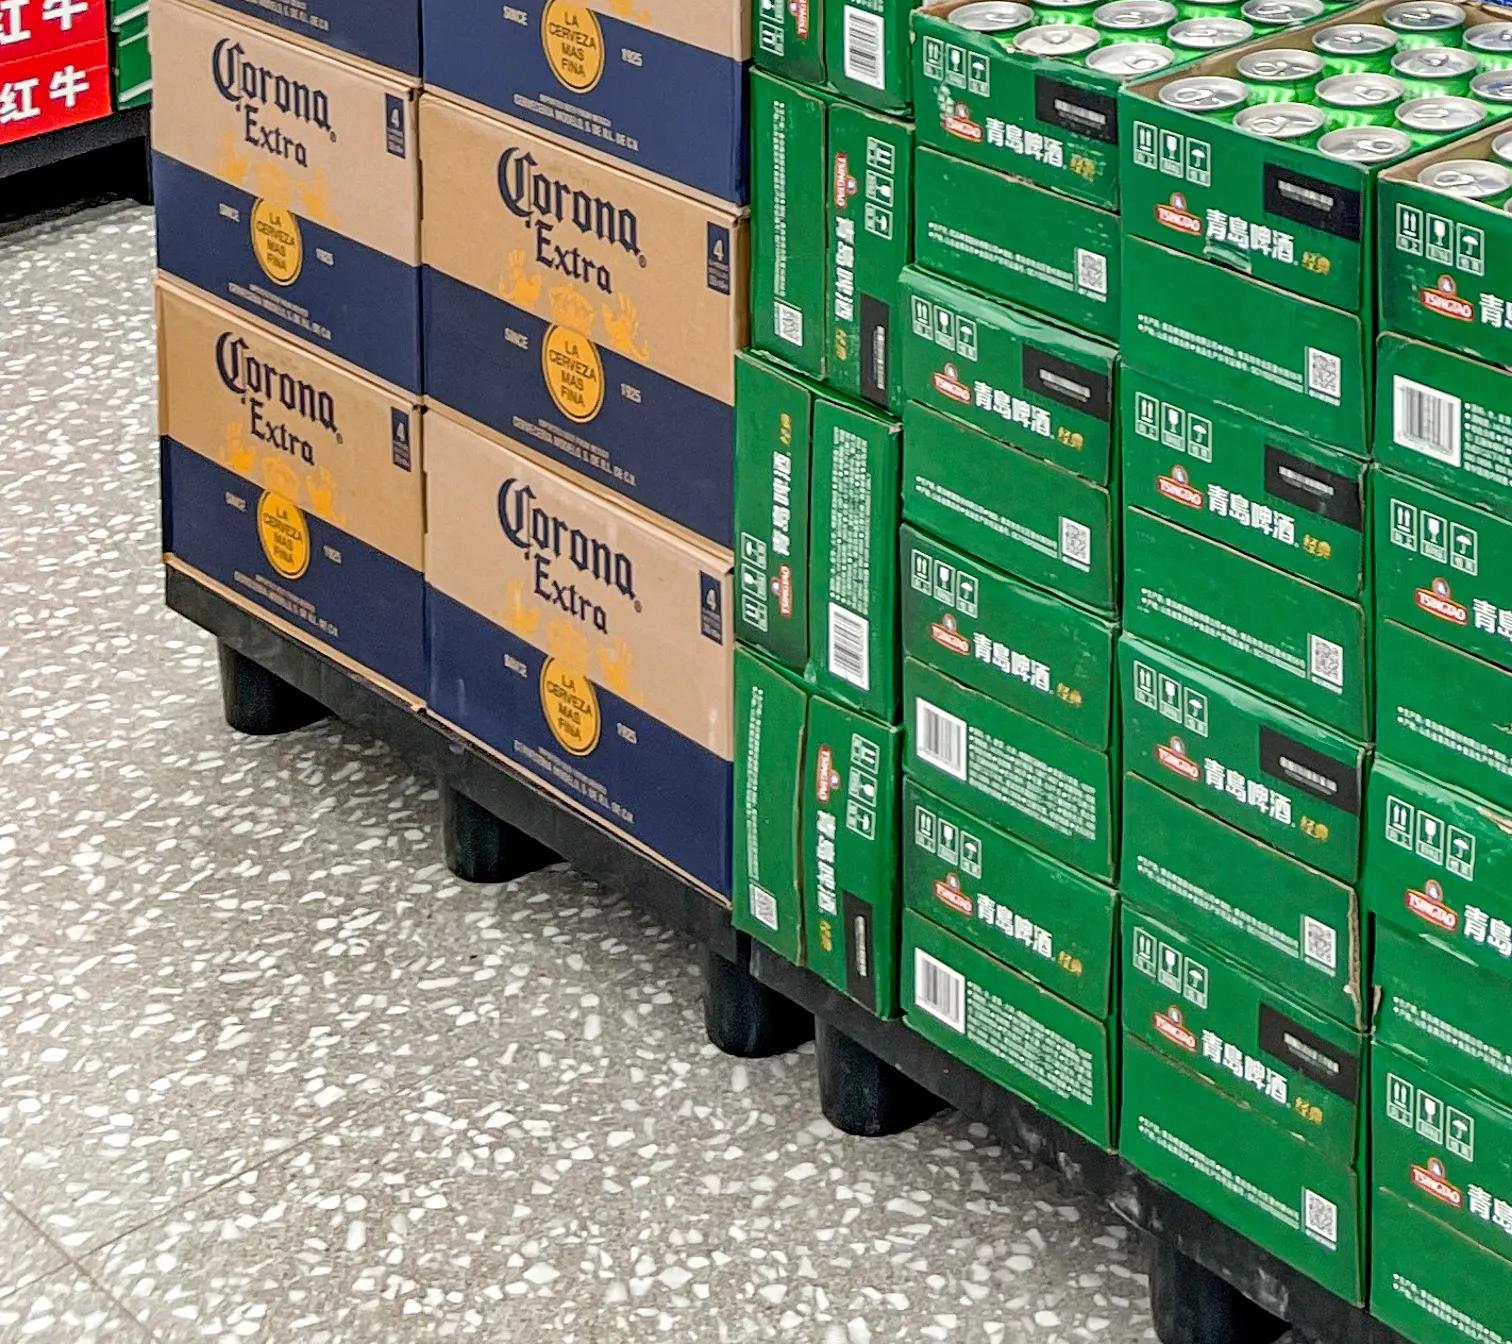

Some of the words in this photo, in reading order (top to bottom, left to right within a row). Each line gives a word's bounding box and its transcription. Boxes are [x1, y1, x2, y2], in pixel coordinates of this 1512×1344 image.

[1, 64, 90, 124] 红牛
[212, 37, 330, 130] Corona
[243, 109, 308, 169] Extra
[498, 146, 640, 255] Corona
[534, 223, 612, 295] Extra
[713, 238, 724, 262] 4
[1206, 209, 1295, 265] 青岛啤酒
[561, 369, 585, 391] MAS
[564, 340, 580, 359] LA
[216, 331, 336, 433] Corona
[561, 385, 586, 408] FINA
[974, 382, 1051, 436] 青岛啤酒
[249, 399, 315, 467] Extra
[498, 477, 635, 599] Corona
[1207, 483, 1296, 544] 青岛啤酒
[533, 556, 609, 635] Extra
[1200, 1030, 1288, 1103] 青岛啤酒
